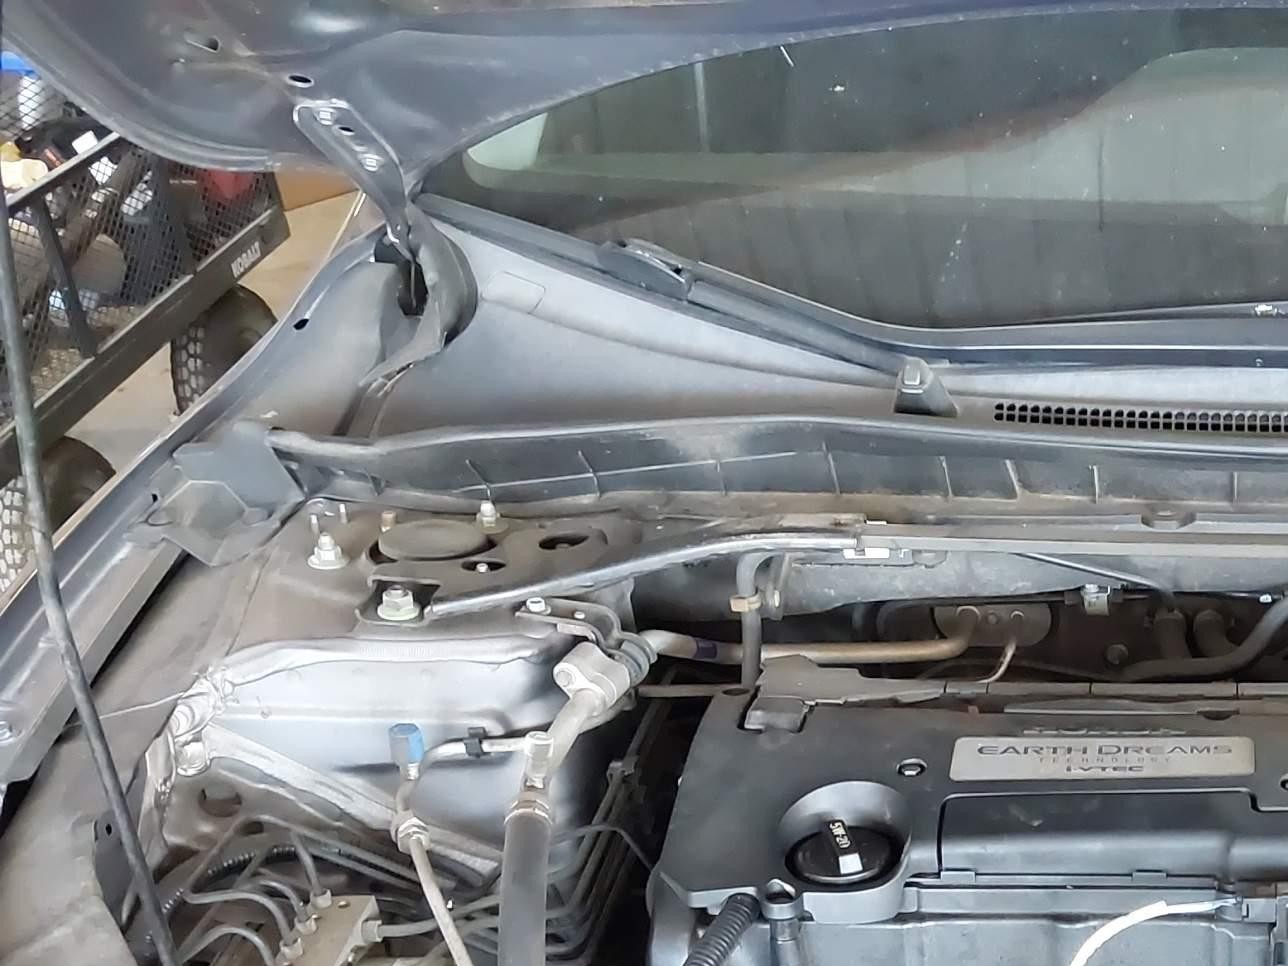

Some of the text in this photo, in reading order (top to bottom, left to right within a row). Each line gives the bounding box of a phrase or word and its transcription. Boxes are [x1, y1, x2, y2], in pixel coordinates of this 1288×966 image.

[977, 744, 1232, 756] EARTH DREAMS
[1039, 756, 1172, 764] TECHNOLOGY
[829, 821, 851, 848] 5W-20
